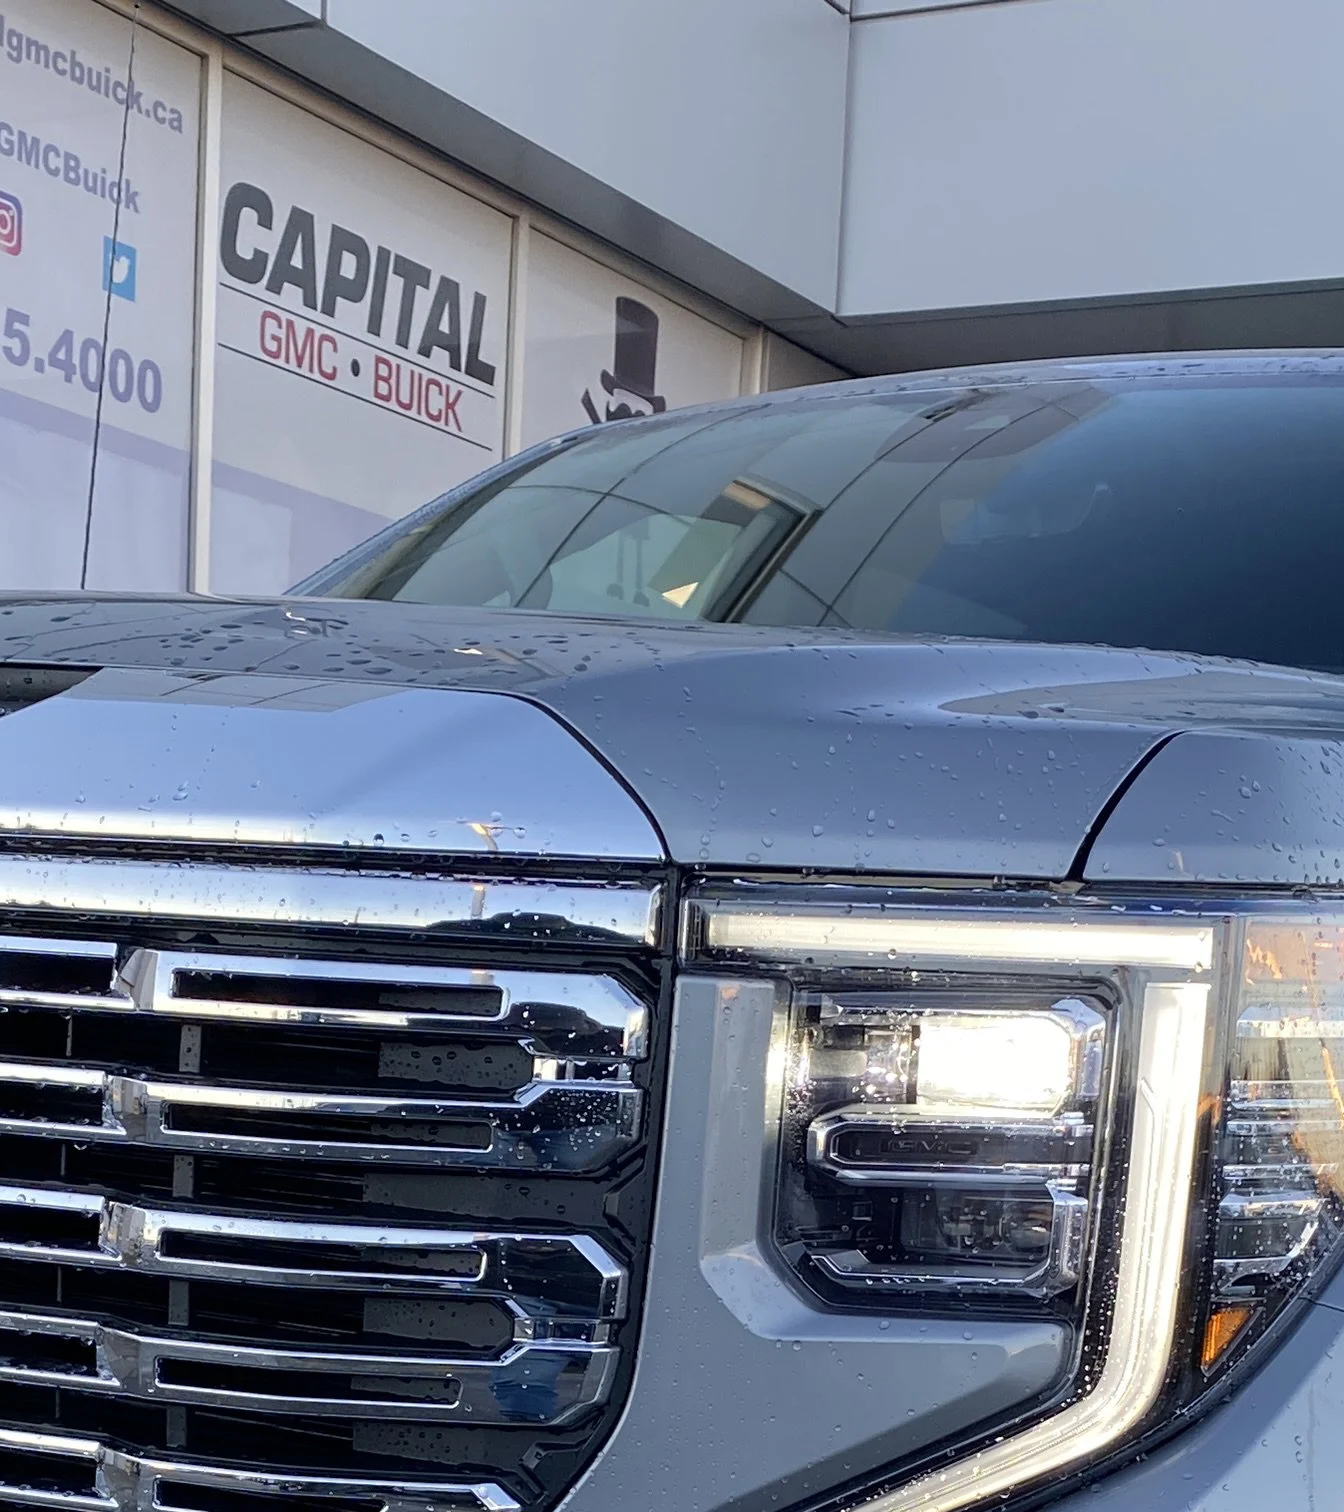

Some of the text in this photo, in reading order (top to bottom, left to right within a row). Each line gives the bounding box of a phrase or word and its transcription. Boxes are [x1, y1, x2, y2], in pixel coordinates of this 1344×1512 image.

[219, 181, 496, 387] CAPITAL
[259, 310, 464, 433] GMC BUICK
